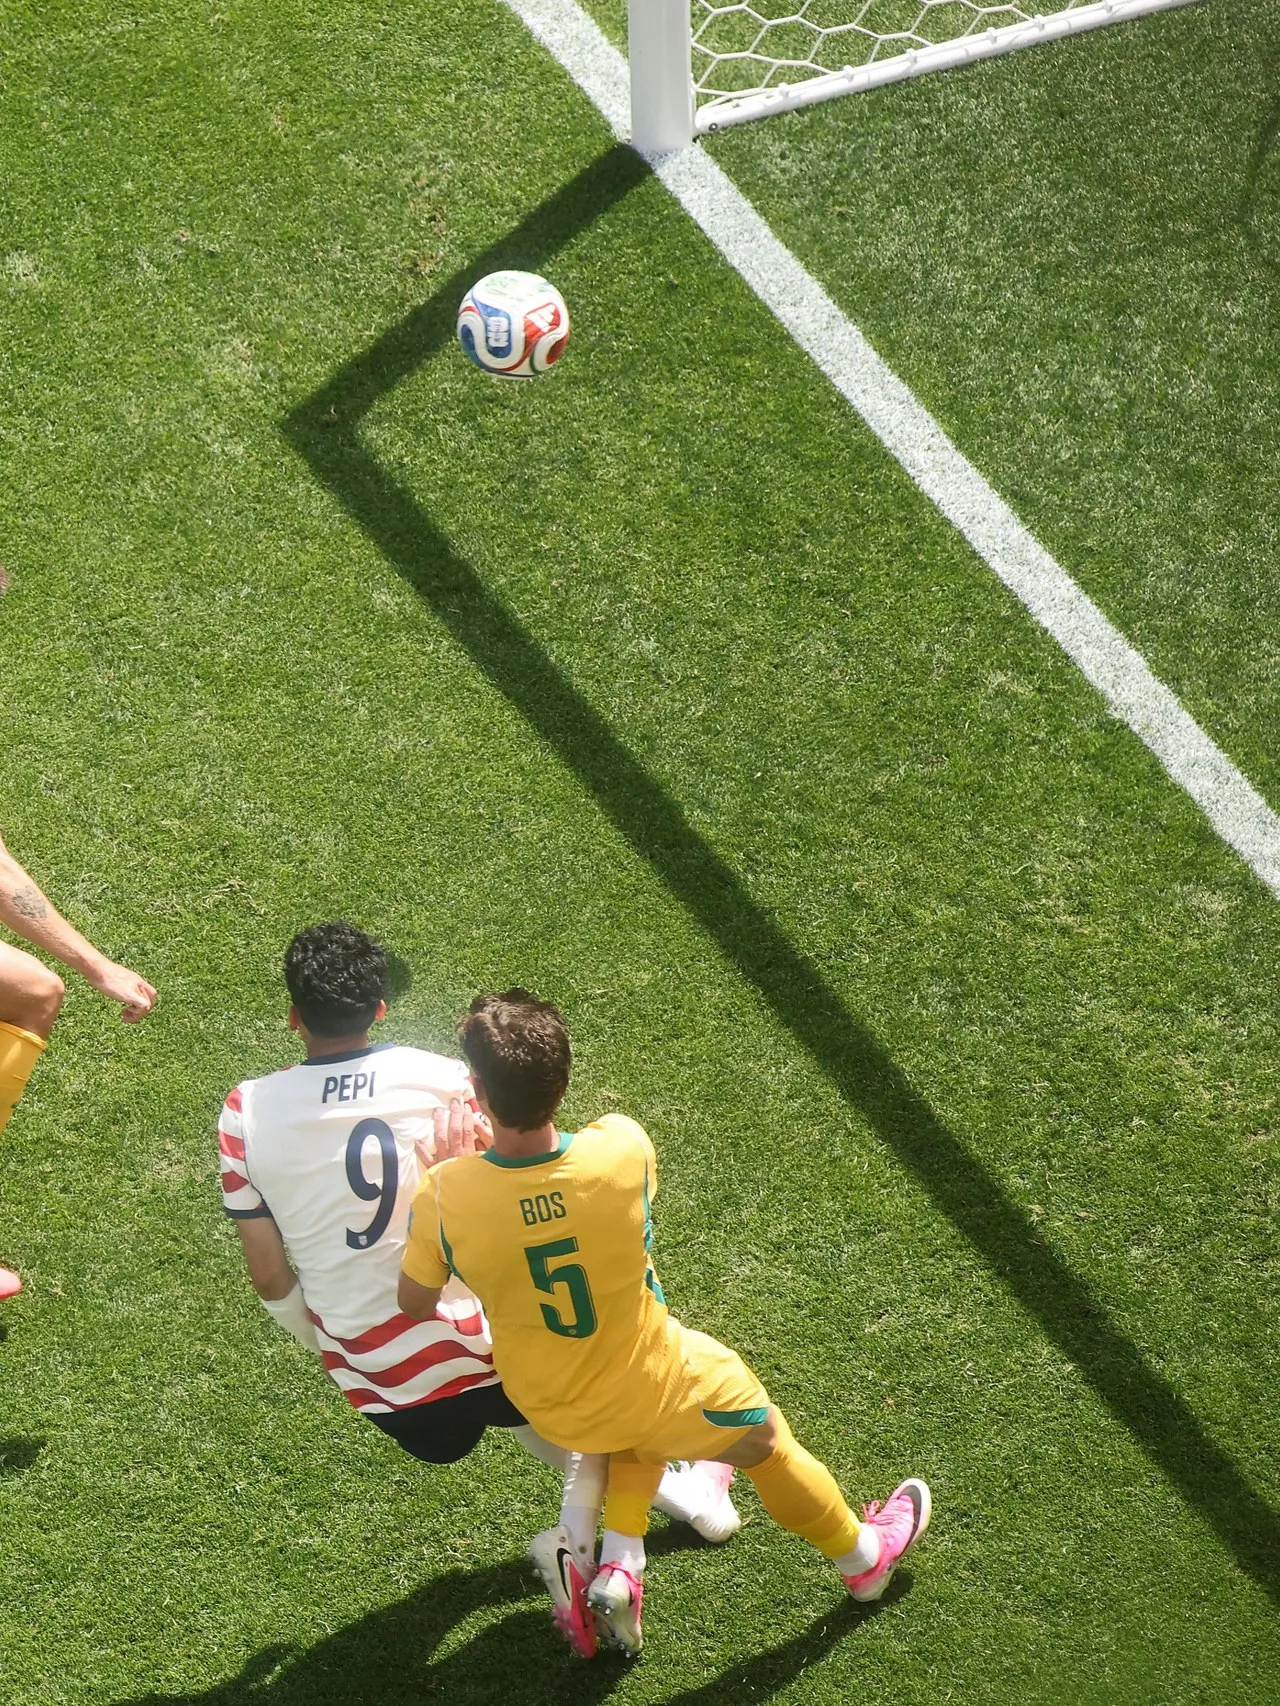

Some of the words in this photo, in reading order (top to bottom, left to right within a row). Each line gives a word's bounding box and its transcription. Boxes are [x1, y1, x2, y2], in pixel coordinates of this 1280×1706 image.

[322, 1071, 376, 1103] PEPI
[346, 1117, 399, 1250] 9
[520, 1191, 567, 1227] BOS
[523, 1236, 598, 1338] 5
